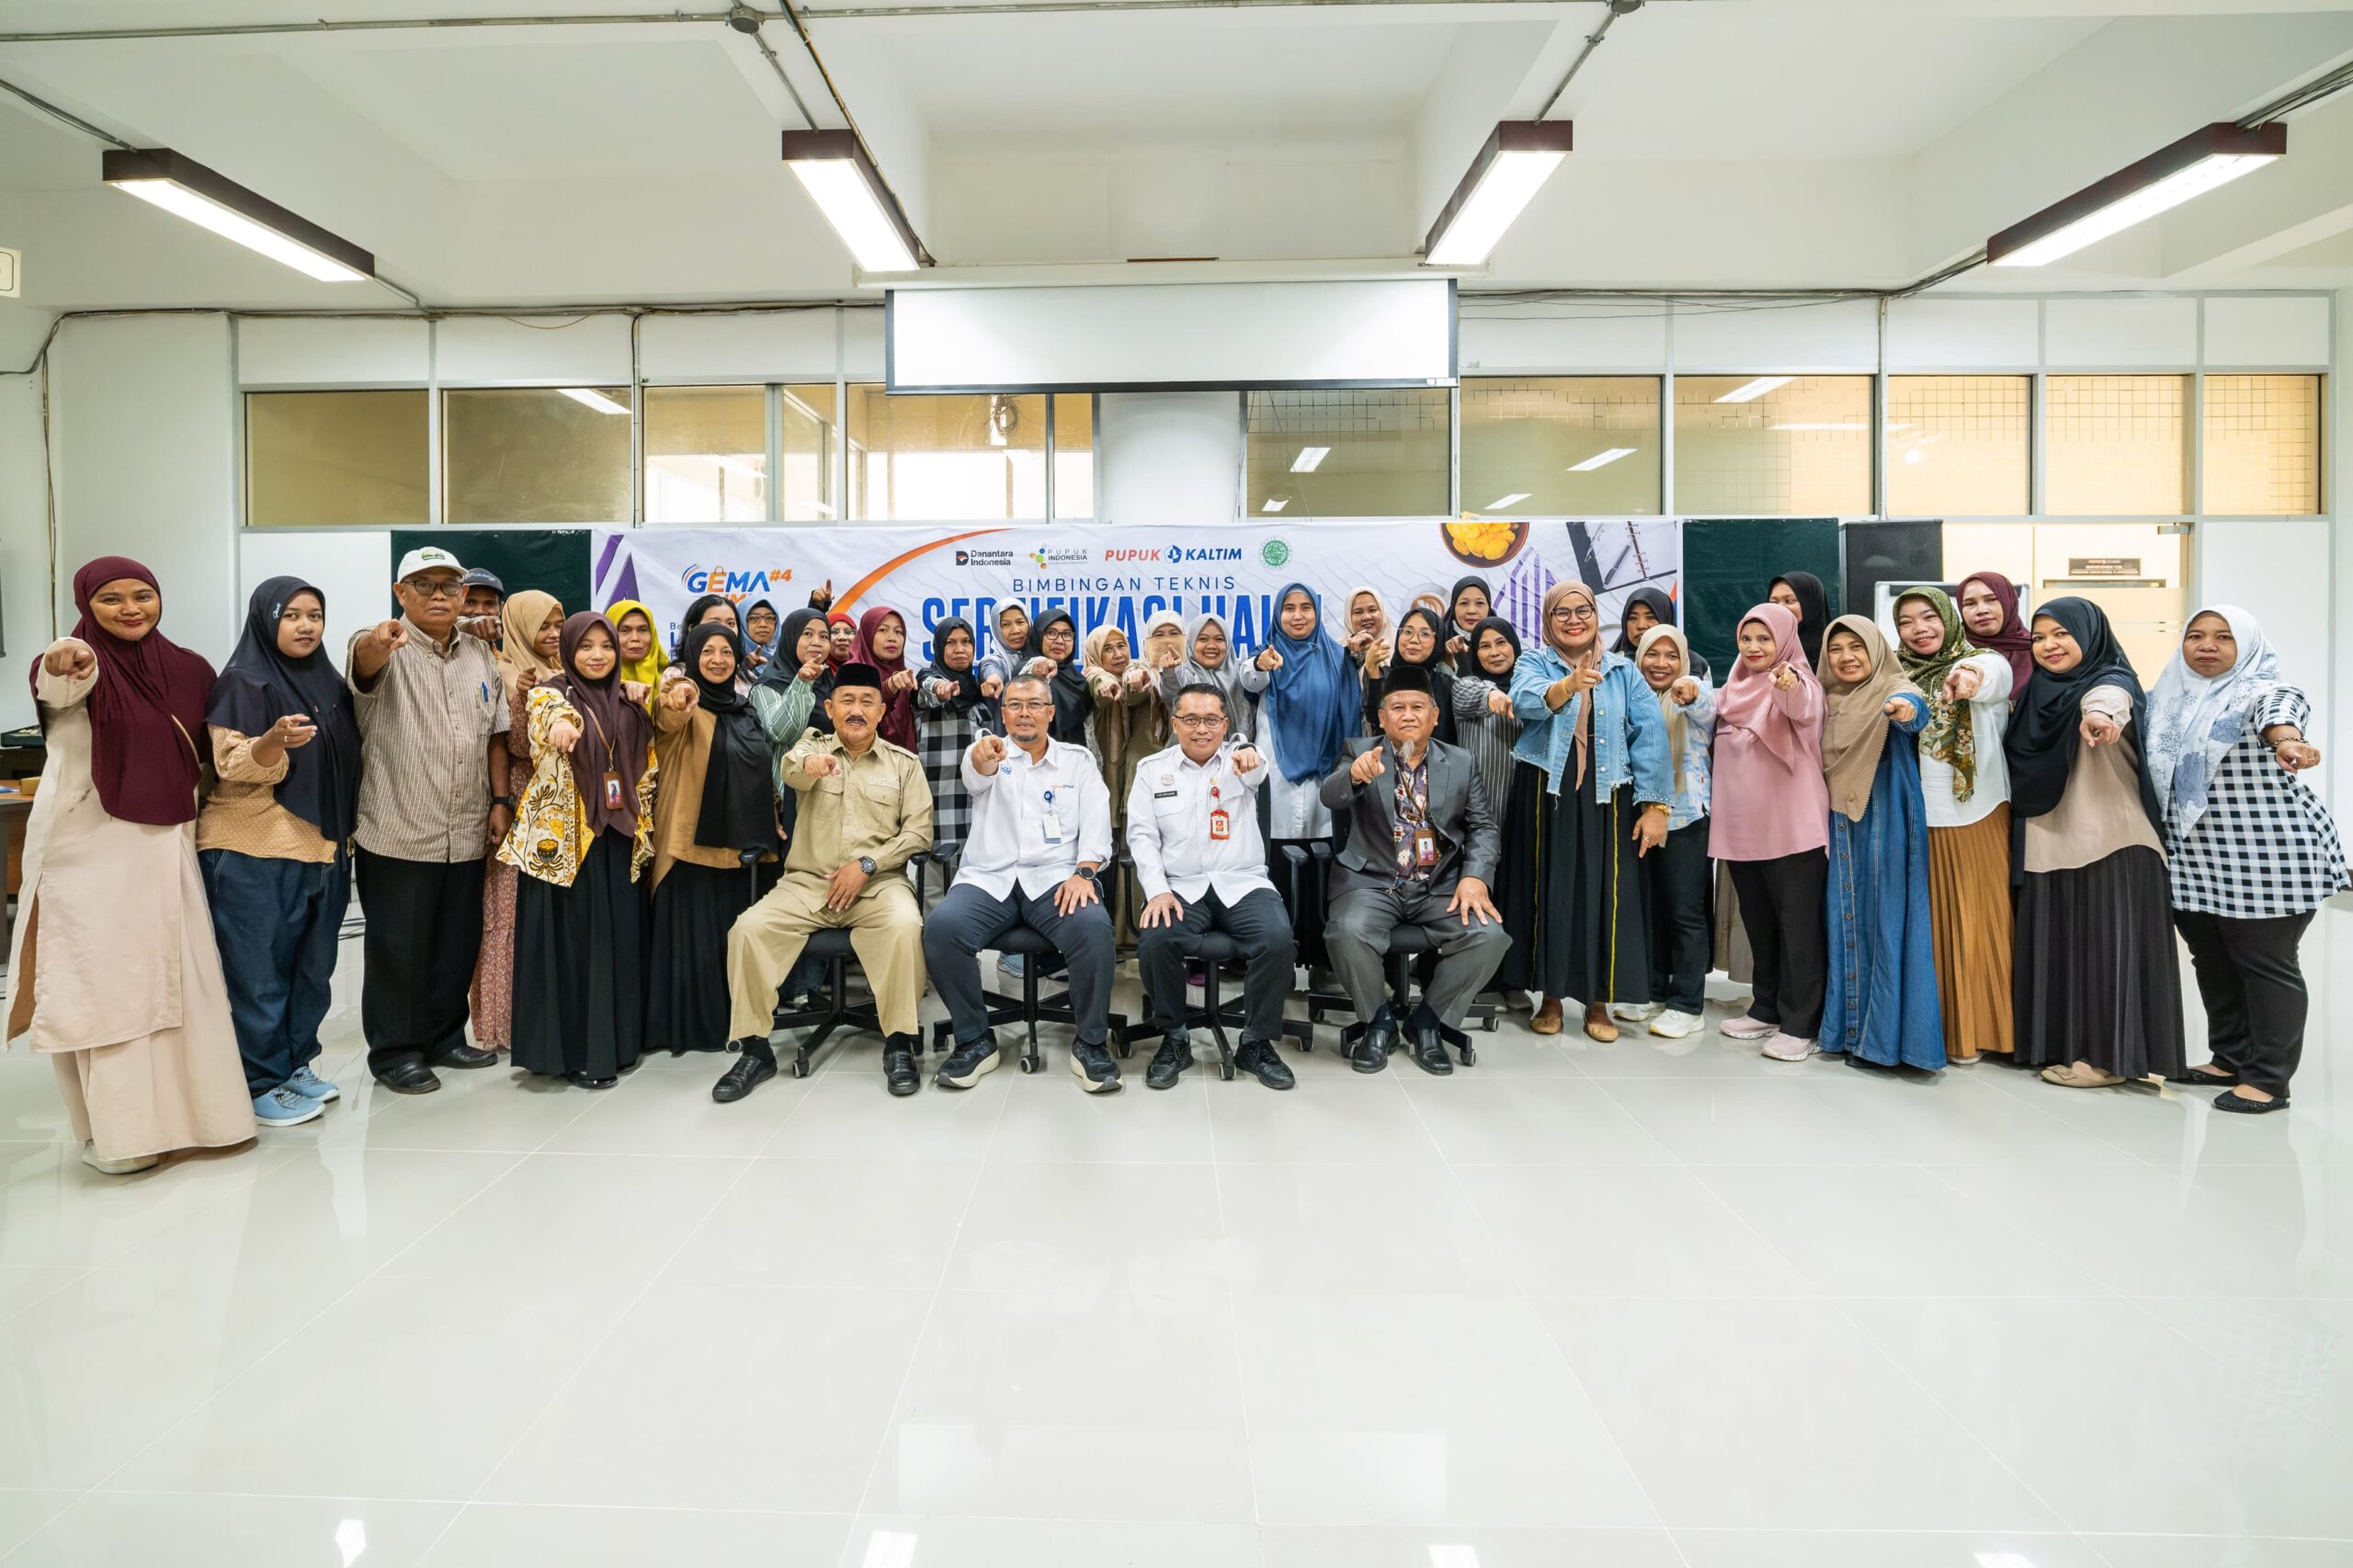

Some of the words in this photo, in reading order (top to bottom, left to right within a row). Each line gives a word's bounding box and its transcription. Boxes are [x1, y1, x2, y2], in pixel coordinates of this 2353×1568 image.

[971, 550, 1014, 558] Danantara
[1105, 549, 1161, 561] PUPUK
[1185, 548, 1242, 561] KALTIM
[971, 558, 1011, 566] Indonesia
[687, 571, 770, 593] GEMA
[769, 569, 792, 581] #4
[1013, 577, 1141, 592] BIMBINGAN
[1154, 576, 1234, 590] TEKNIS
